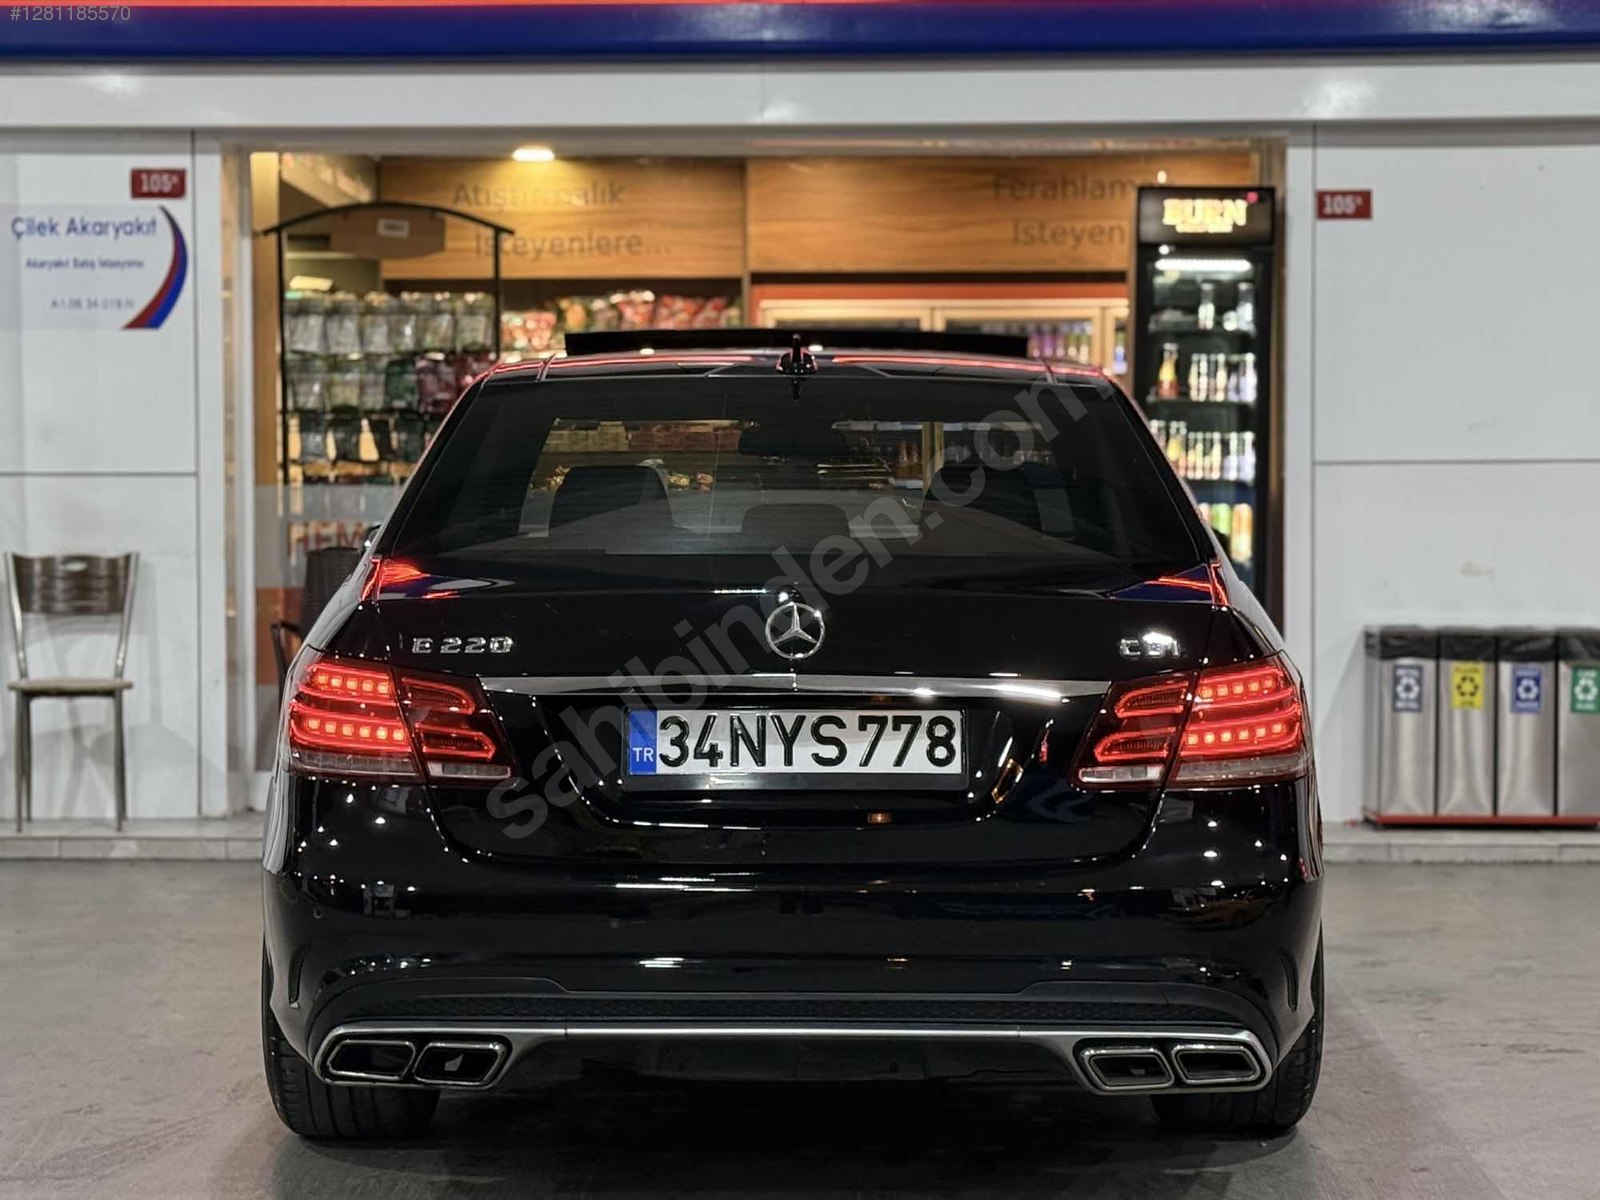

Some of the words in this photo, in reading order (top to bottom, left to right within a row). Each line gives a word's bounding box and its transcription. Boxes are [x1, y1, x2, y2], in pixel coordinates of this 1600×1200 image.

[11, 216, 60, 240] Çilek
[65, 216, 157, 240] Akaryakıt
[412, 637, 434, 653] E
[440, 636, 514, 653] 220
[632, 747, 654, 763] TR
[658, 714, 957, 768] 34NYS778
